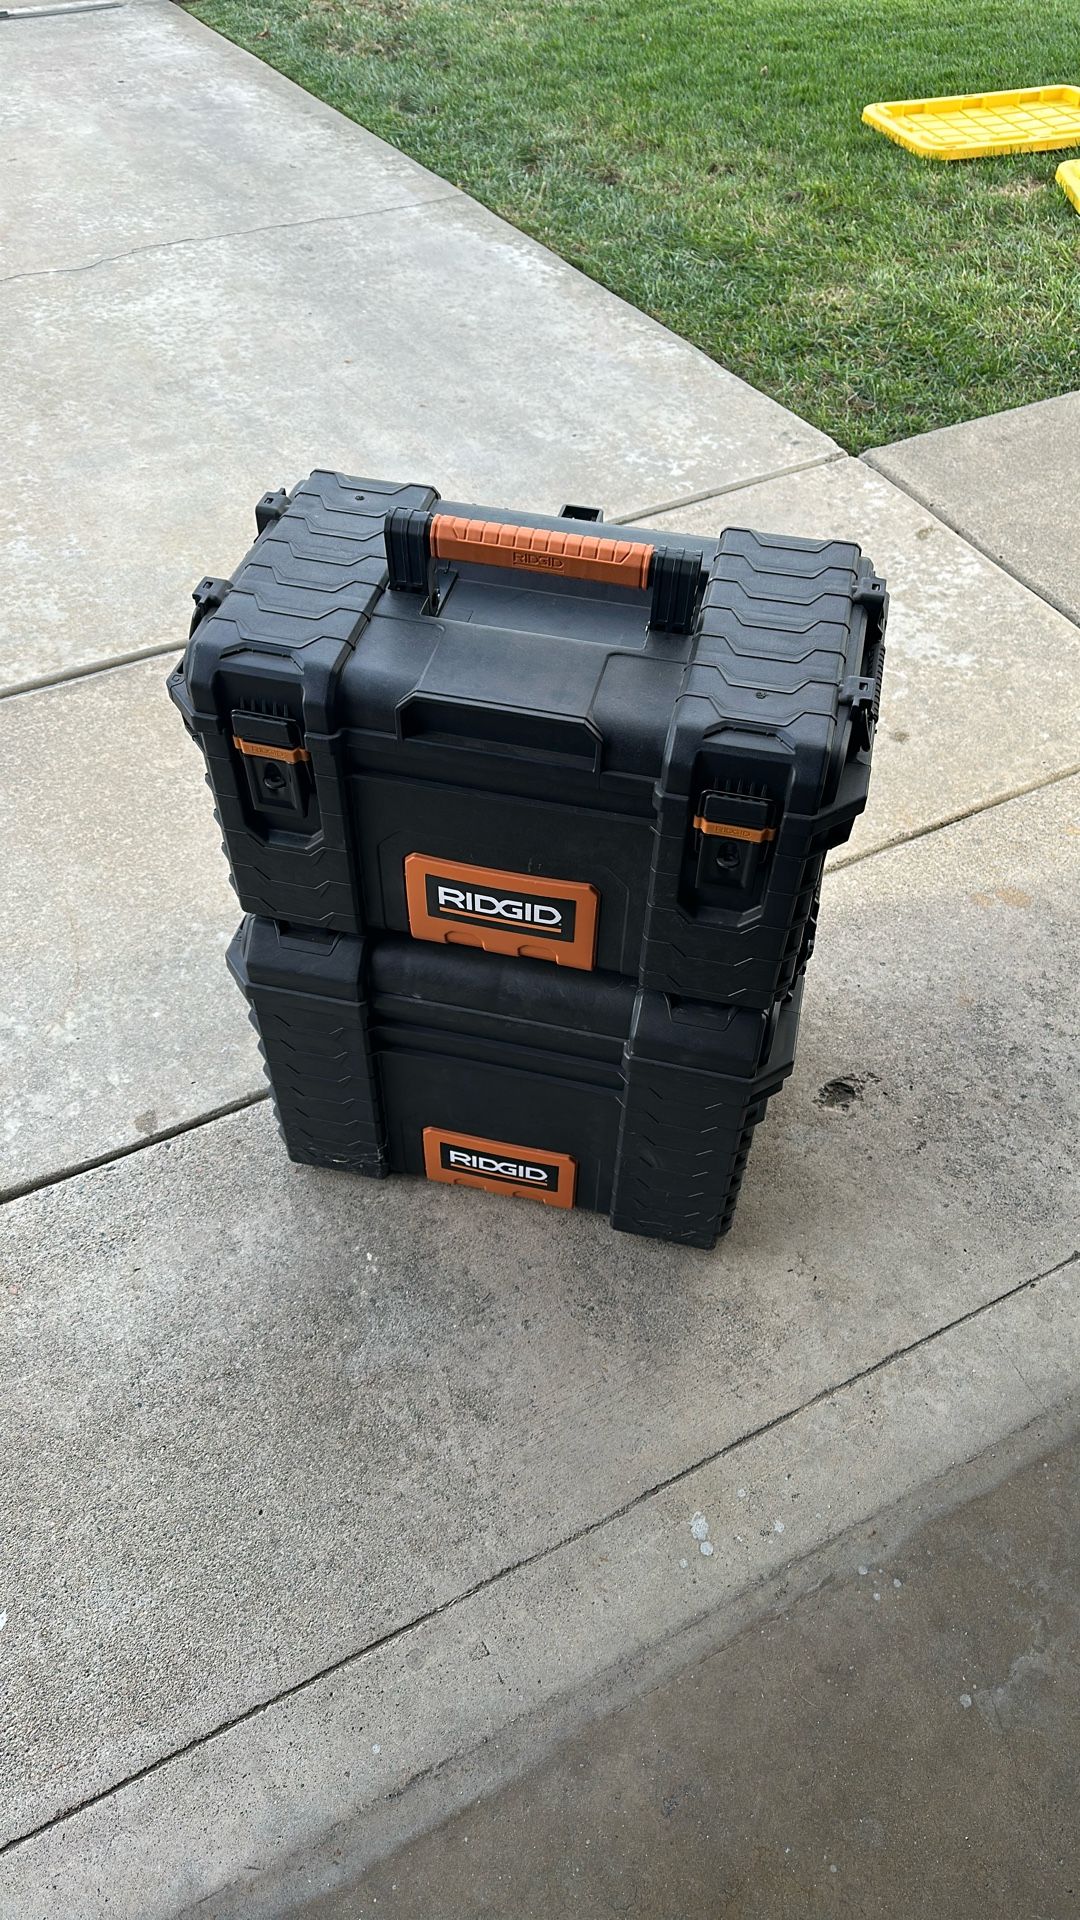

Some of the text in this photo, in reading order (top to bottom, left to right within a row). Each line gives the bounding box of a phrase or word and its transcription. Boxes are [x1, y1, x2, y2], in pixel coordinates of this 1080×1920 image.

[513, 551, 565, 568] RIDGID
[438, 885, 562, 925] RIDGID
[449, 1149, 548, 1181] RIDGID
